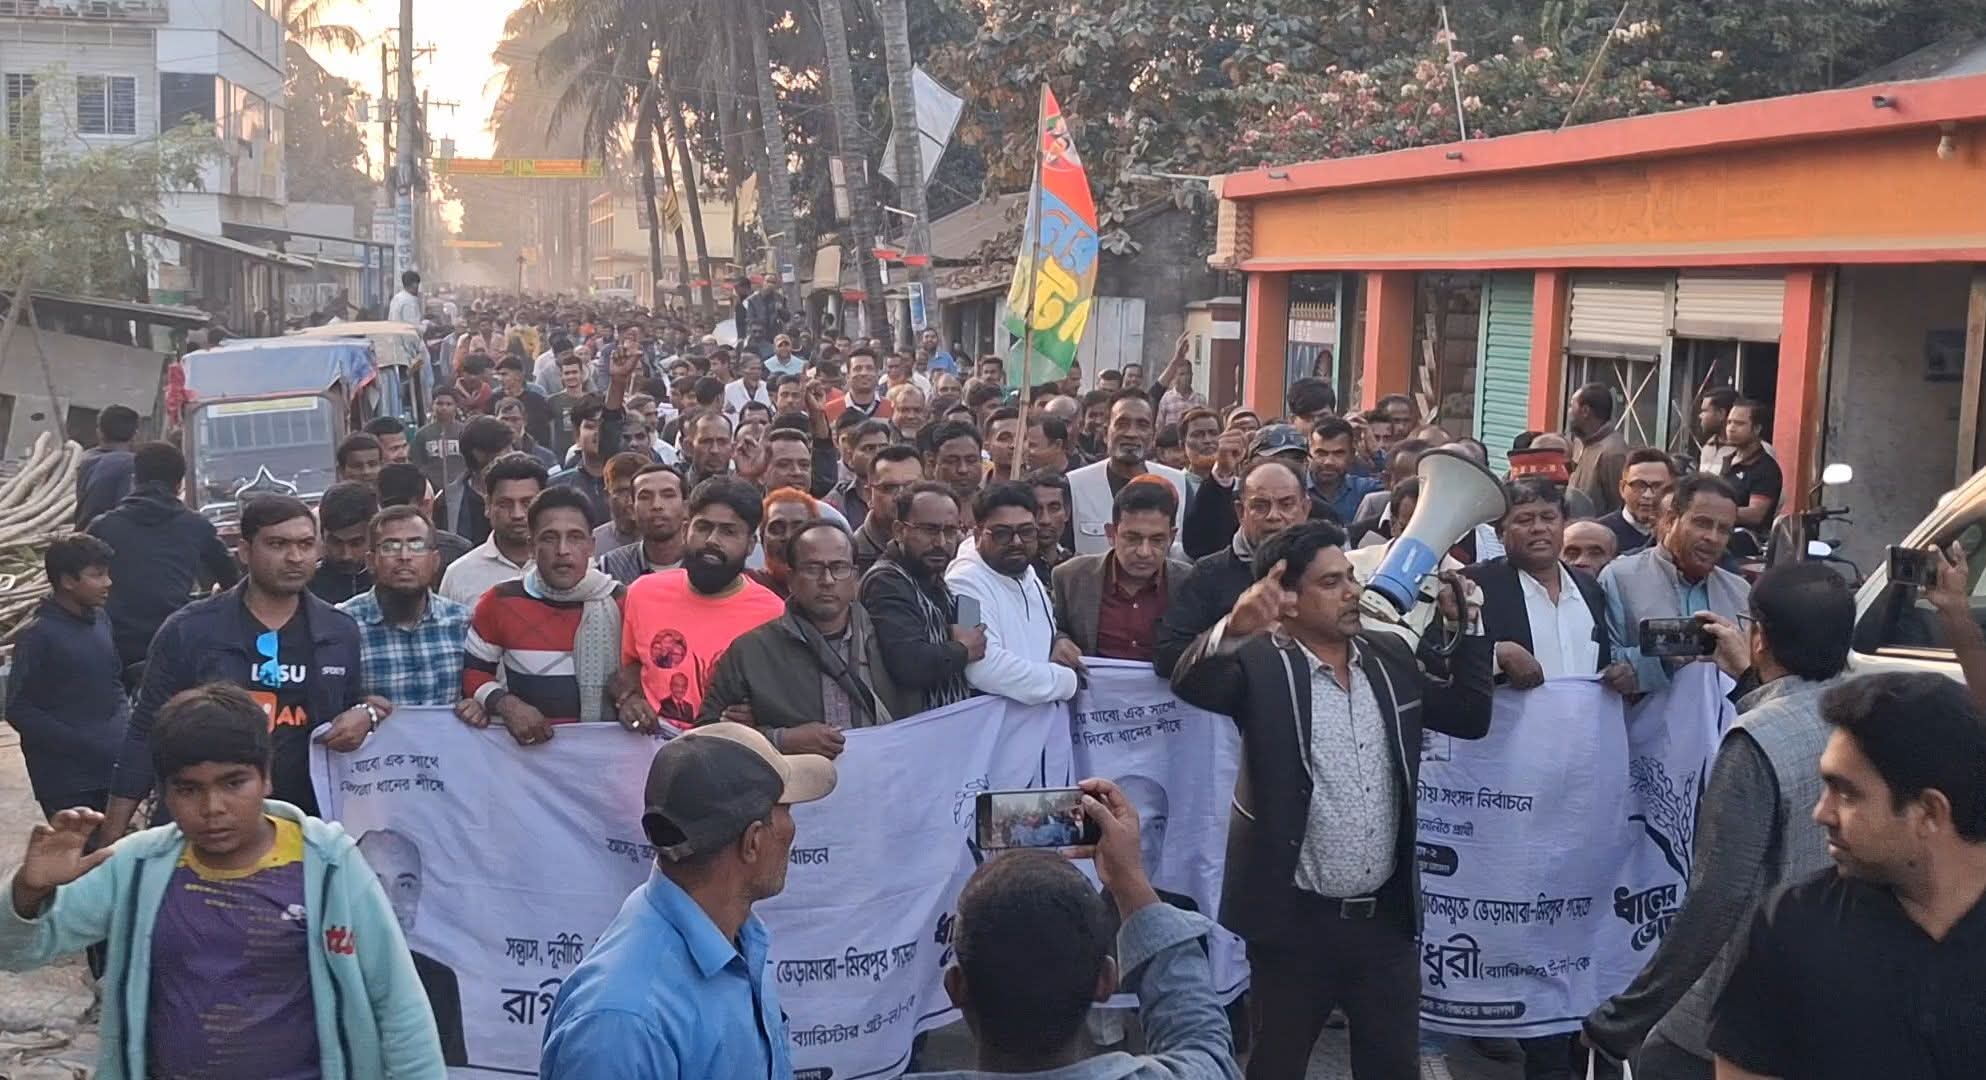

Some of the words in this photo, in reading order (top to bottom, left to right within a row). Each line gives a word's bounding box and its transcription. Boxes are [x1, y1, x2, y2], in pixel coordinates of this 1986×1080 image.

[1124, 705, 1145, 721] এক
[1119, 725, 1152, 743] ধানের
[384, 754, 405, 768] এক
[1442, 788, 1475, 808] সংসদ
[1477, 786, 1535, 813] নির্বাচনে
